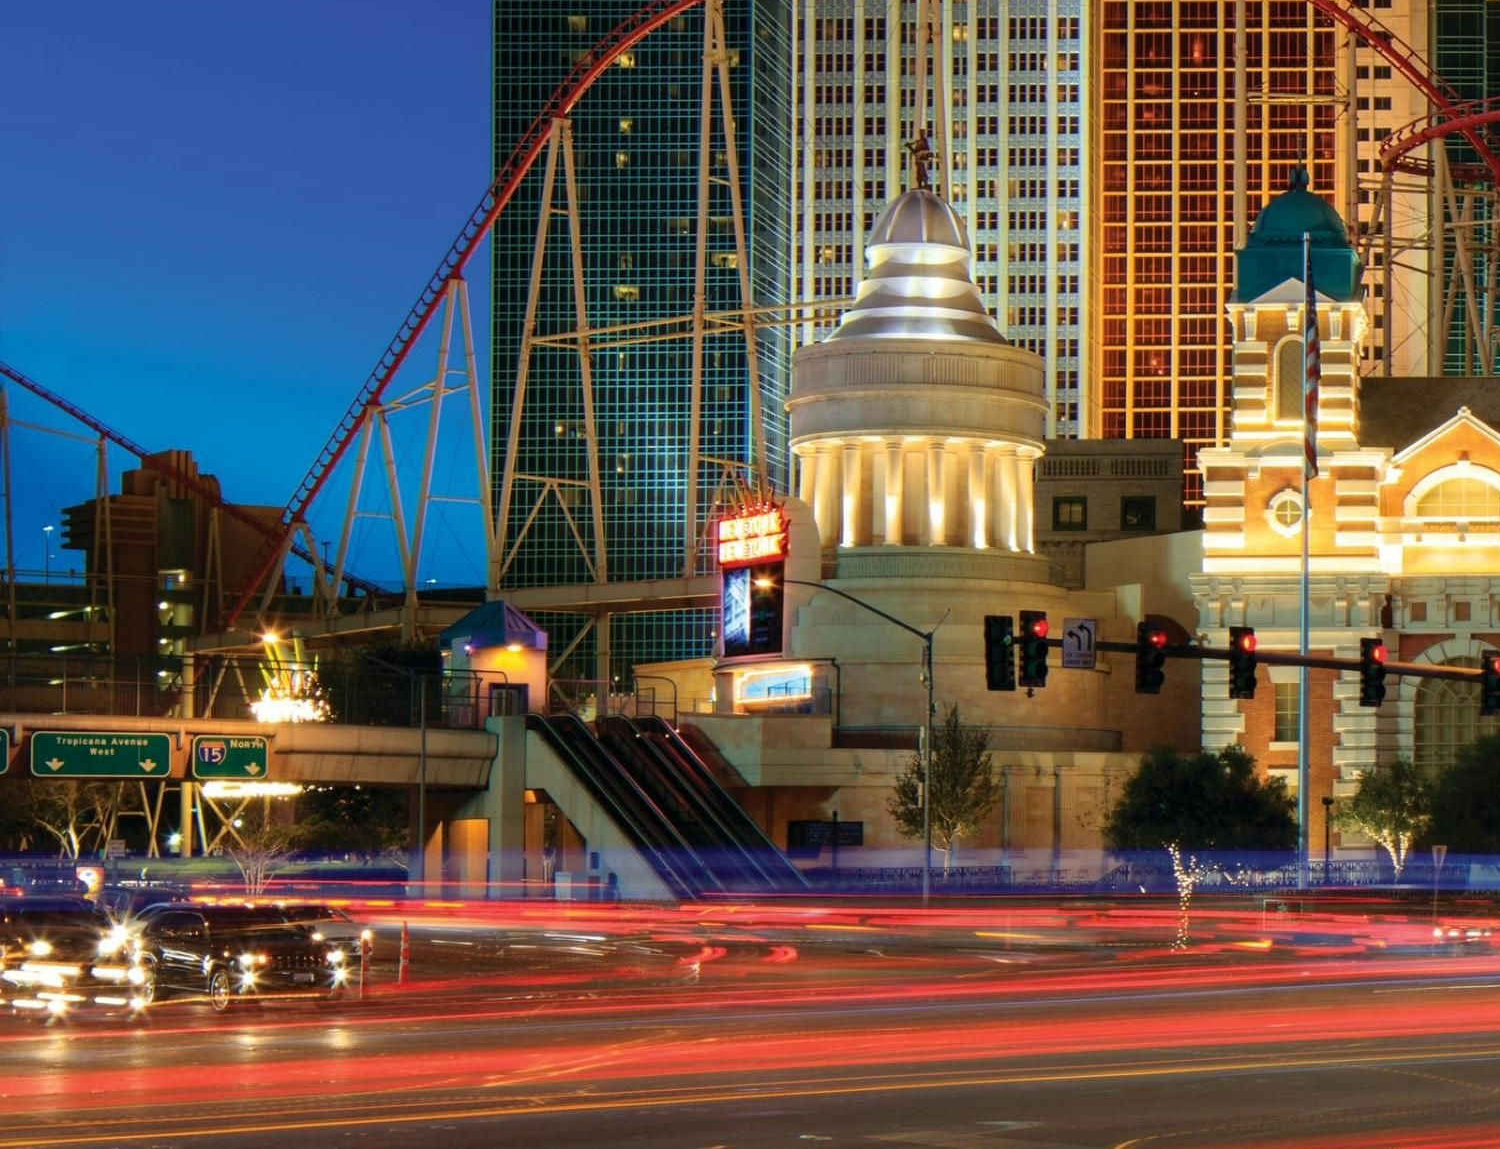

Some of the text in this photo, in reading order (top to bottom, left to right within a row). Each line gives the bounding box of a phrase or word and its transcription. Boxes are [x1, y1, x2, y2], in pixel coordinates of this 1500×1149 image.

[56, 737, 149, 747] Tropicana Avenue
[230, 739, 264, 749] NORTH
[89, 748, 115, 756] West
[204, 747, 222, 763] 15
